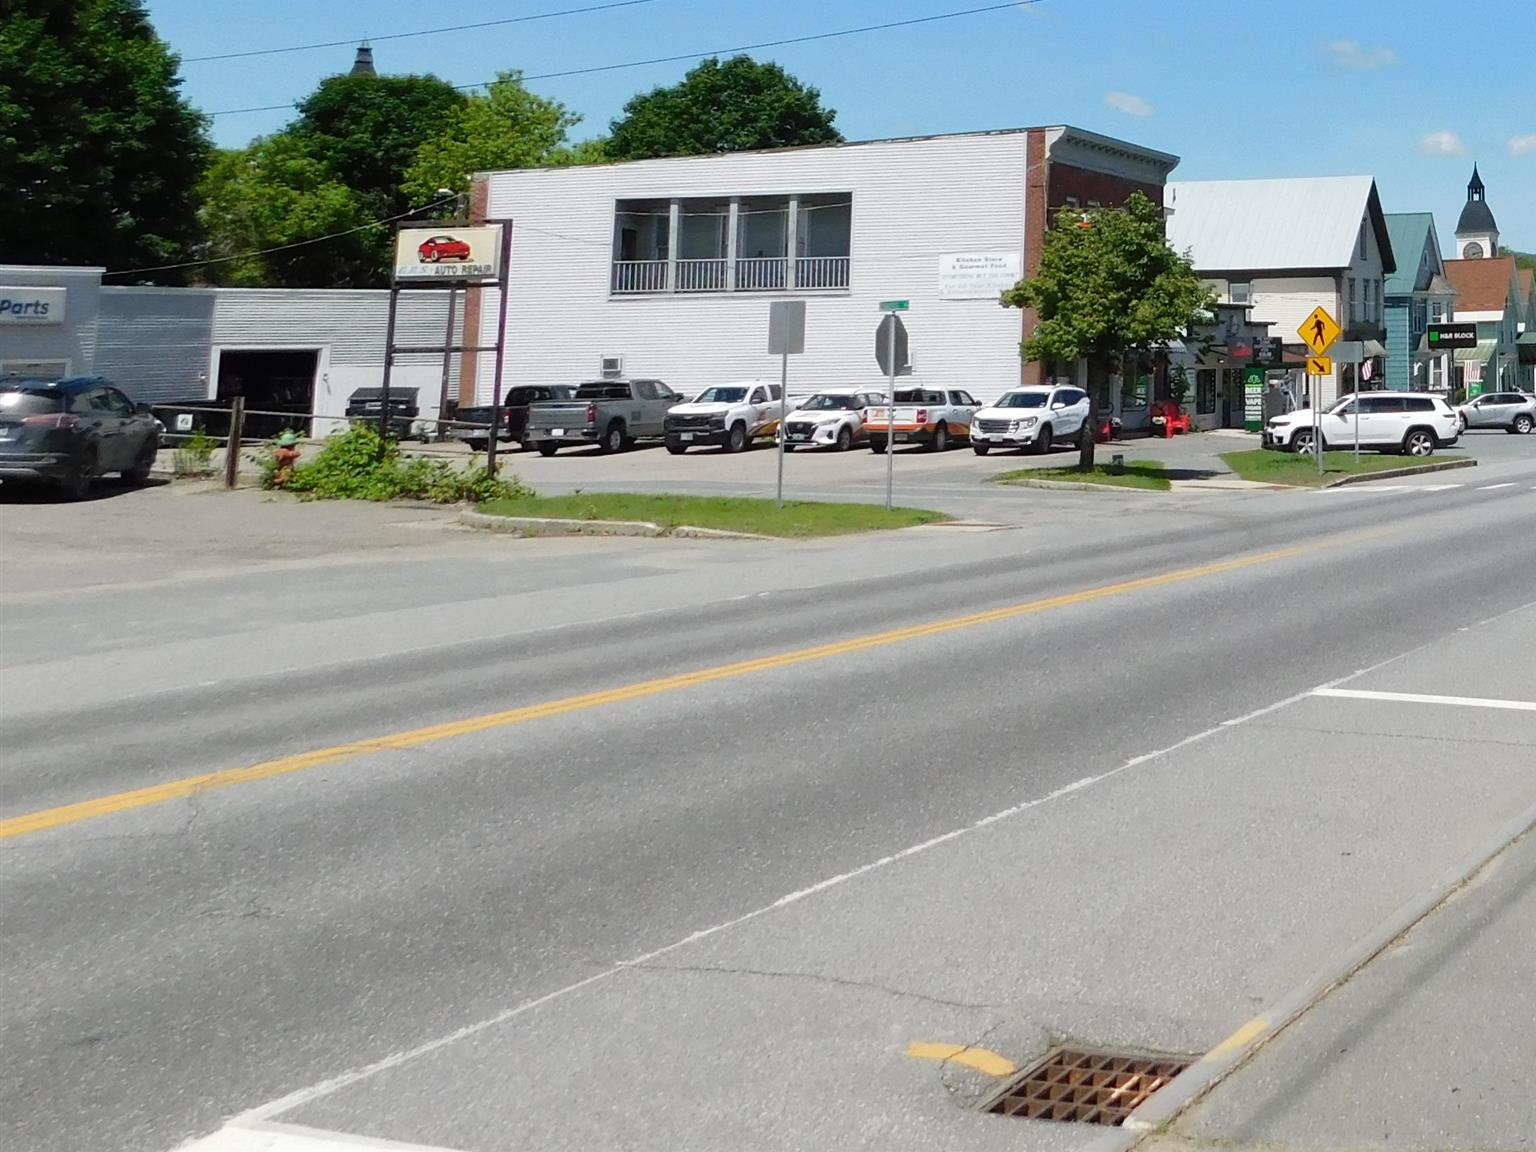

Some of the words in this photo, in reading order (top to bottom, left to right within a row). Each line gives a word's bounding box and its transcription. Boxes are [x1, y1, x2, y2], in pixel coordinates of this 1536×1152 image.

[434, 265, 458, 275] AUTO
[461, 264, 492, 274] REPAIR
[0, 299, 50, 315] Parts
